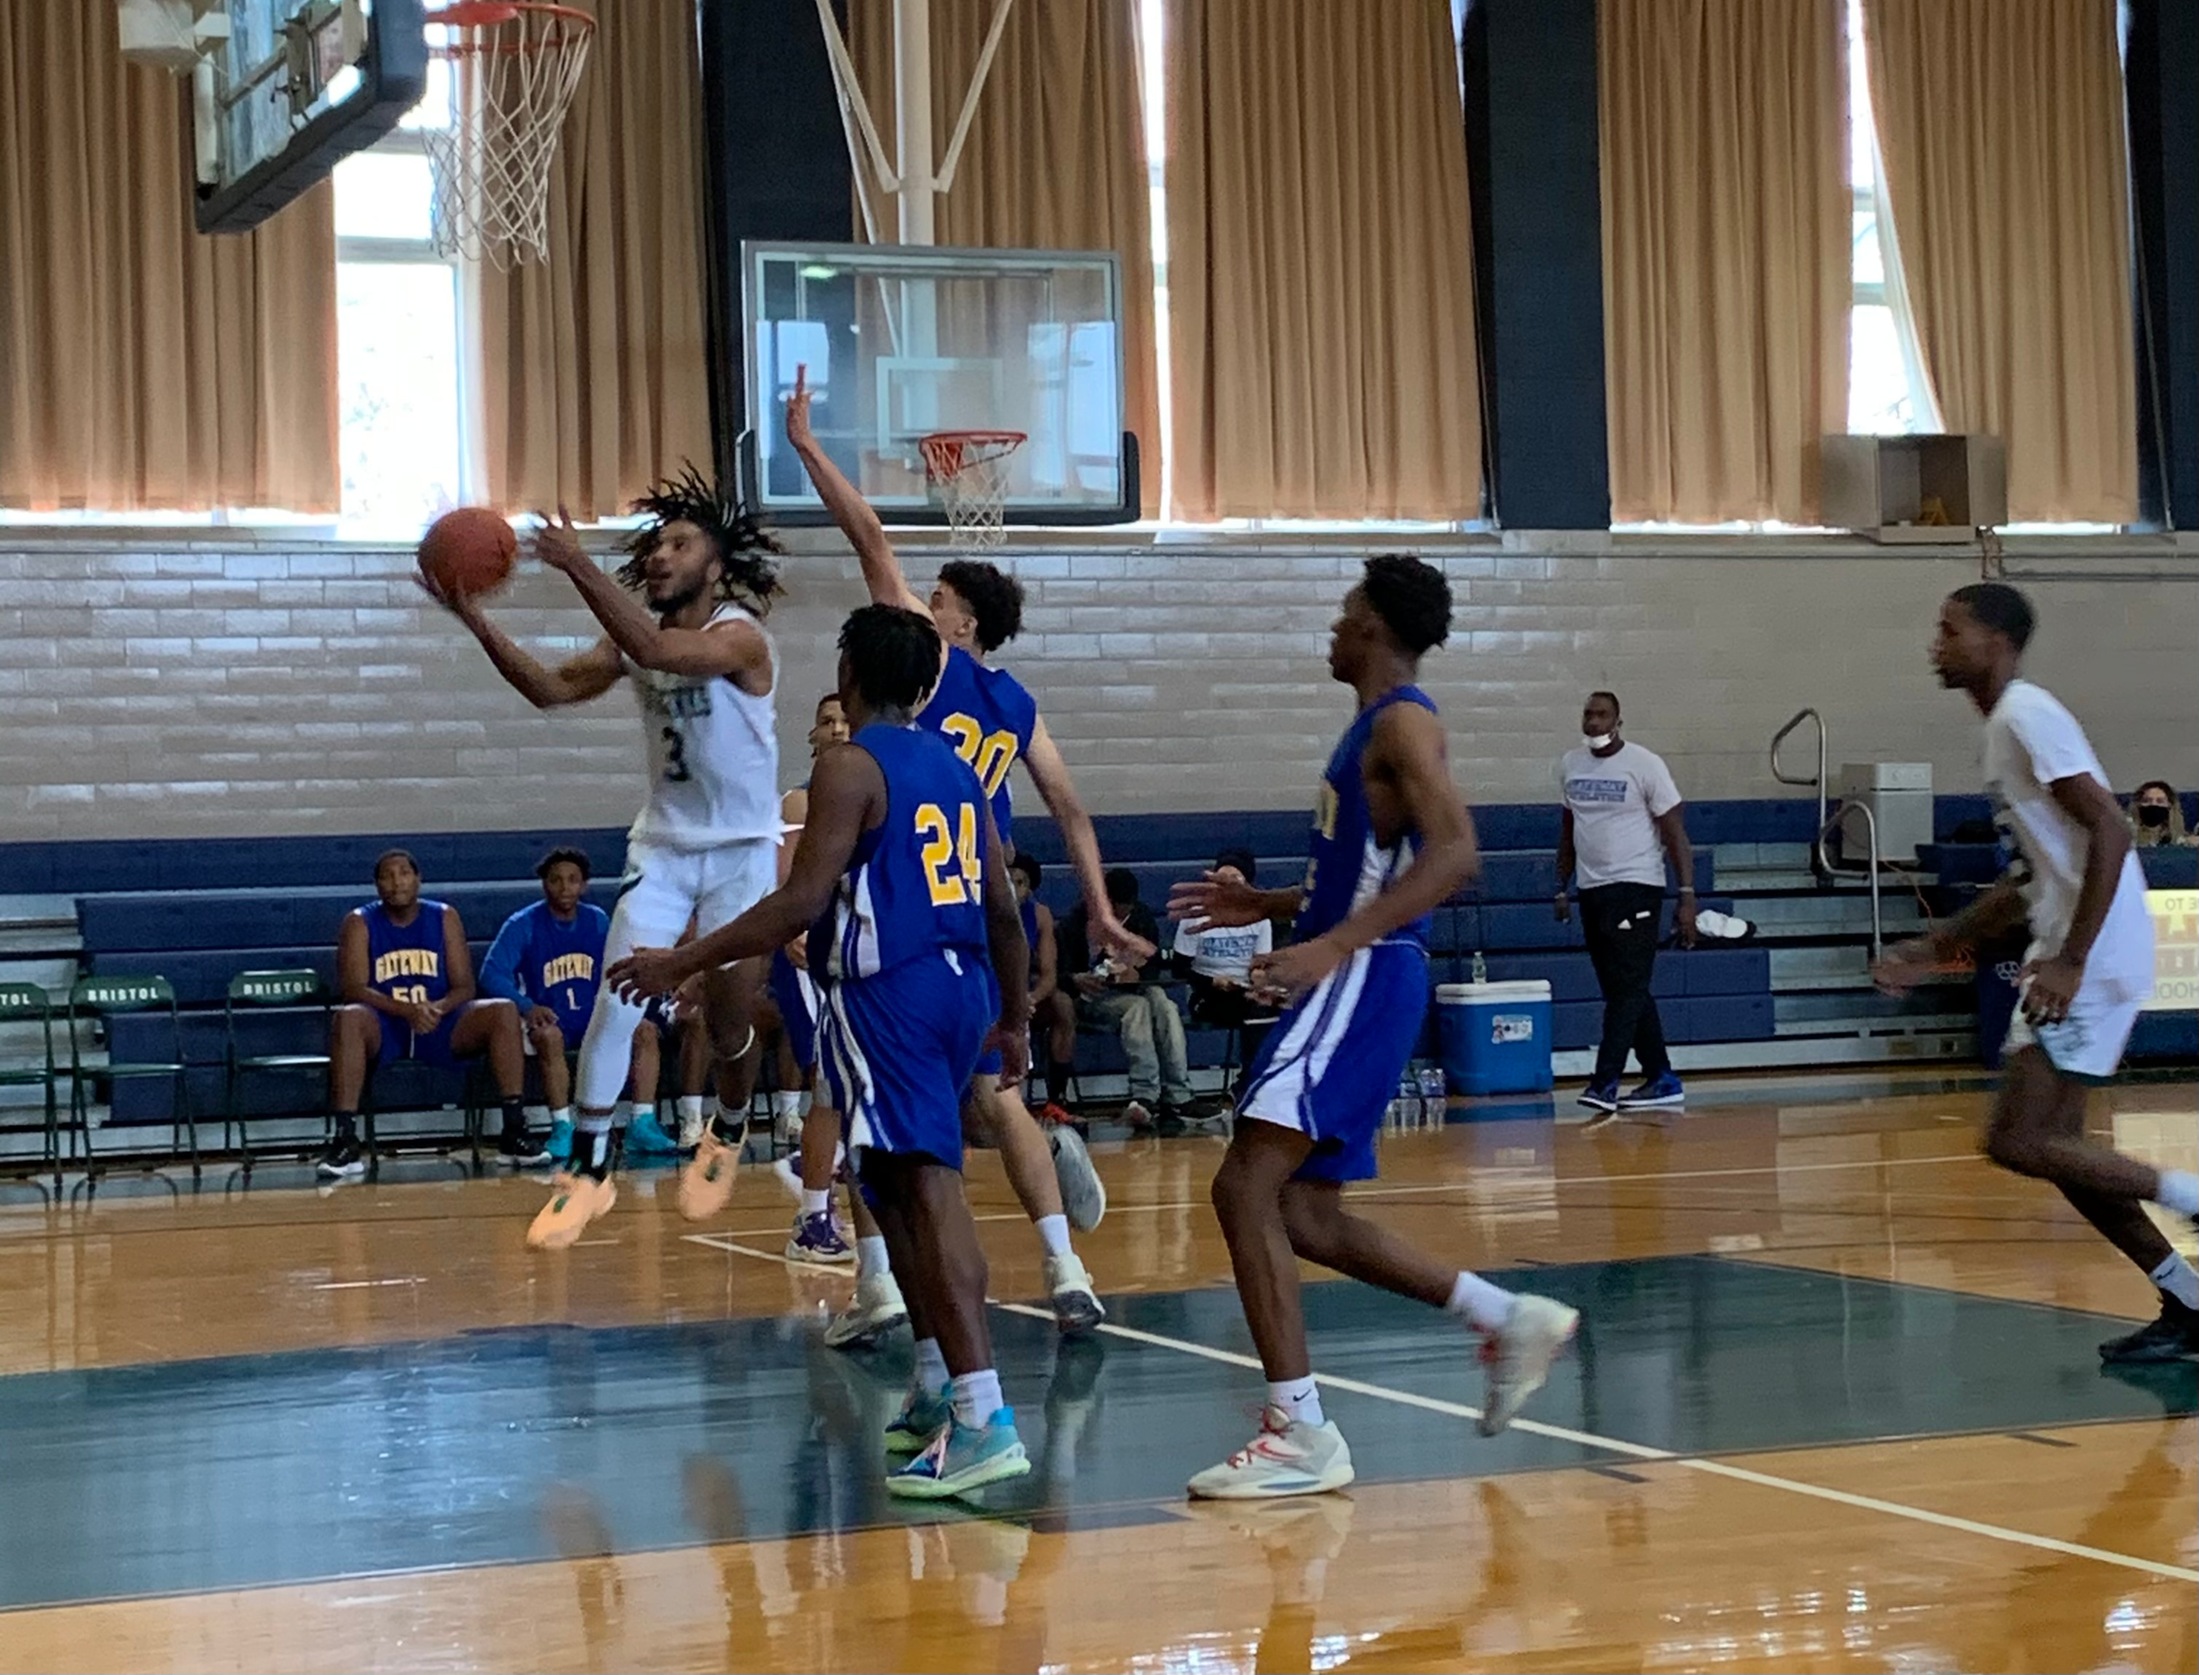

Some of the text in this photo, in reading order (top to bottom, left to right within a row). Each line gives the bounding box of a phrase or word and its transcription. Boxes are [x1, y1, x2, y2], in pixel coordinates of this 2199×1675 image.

[662, 726, 690, 782] 3
[940, 712, 1018, 800] 30
[915, 802, 981, 907] 24
[375, 948, 438, 984] GATEWAY
[543, 953, 594, 988] GATEWAY
[88, 987, 159, 1001] BRISTOL
[243, 981, 313, 995] BRISTOL
[392, 984, 427, 1004] 50
[566, 988, 582, 1010] 1
